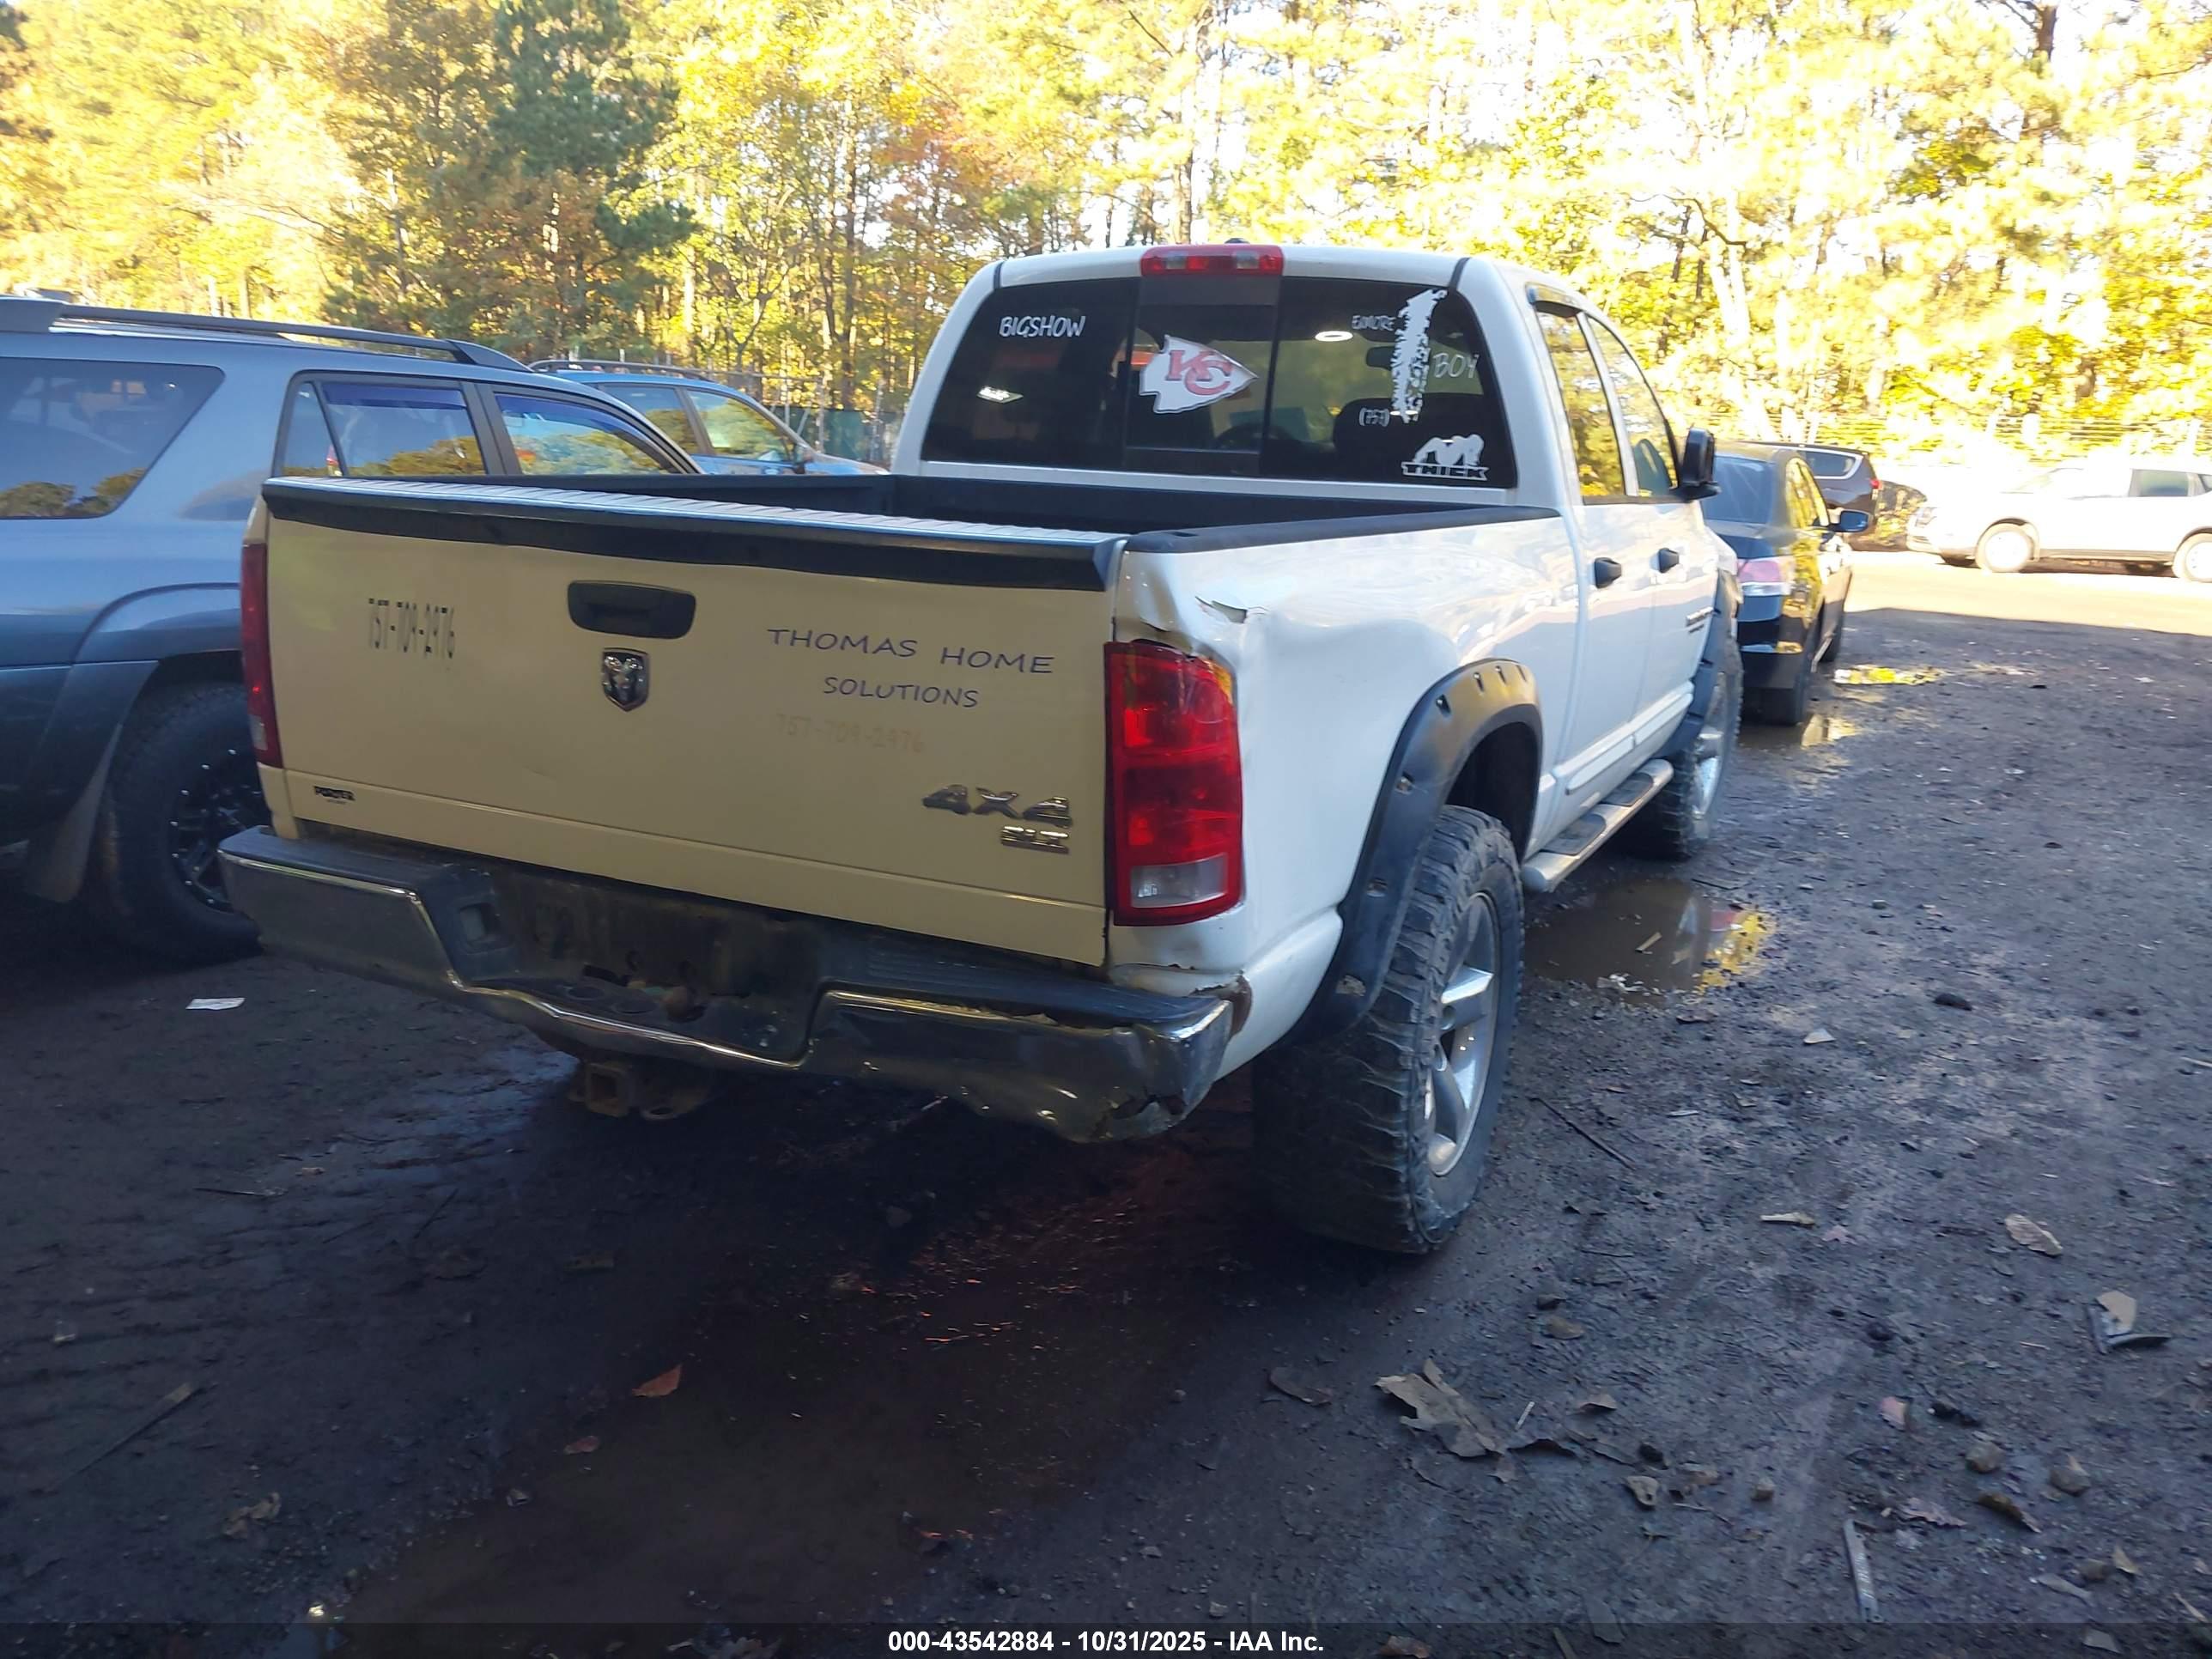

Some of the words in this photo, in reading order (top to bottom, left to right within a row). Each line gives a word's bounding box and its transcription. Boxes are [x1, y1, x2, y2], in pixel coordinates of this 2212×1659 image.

[999, 315, 1086, 337] BIGSHOW
[1165, 349, 1233, 396] KC
[767, 628, 919, 658] THOMAS
[939, 647, 1056, 674] HOME
[823, 677, 980, 708] SOLUTIONS
